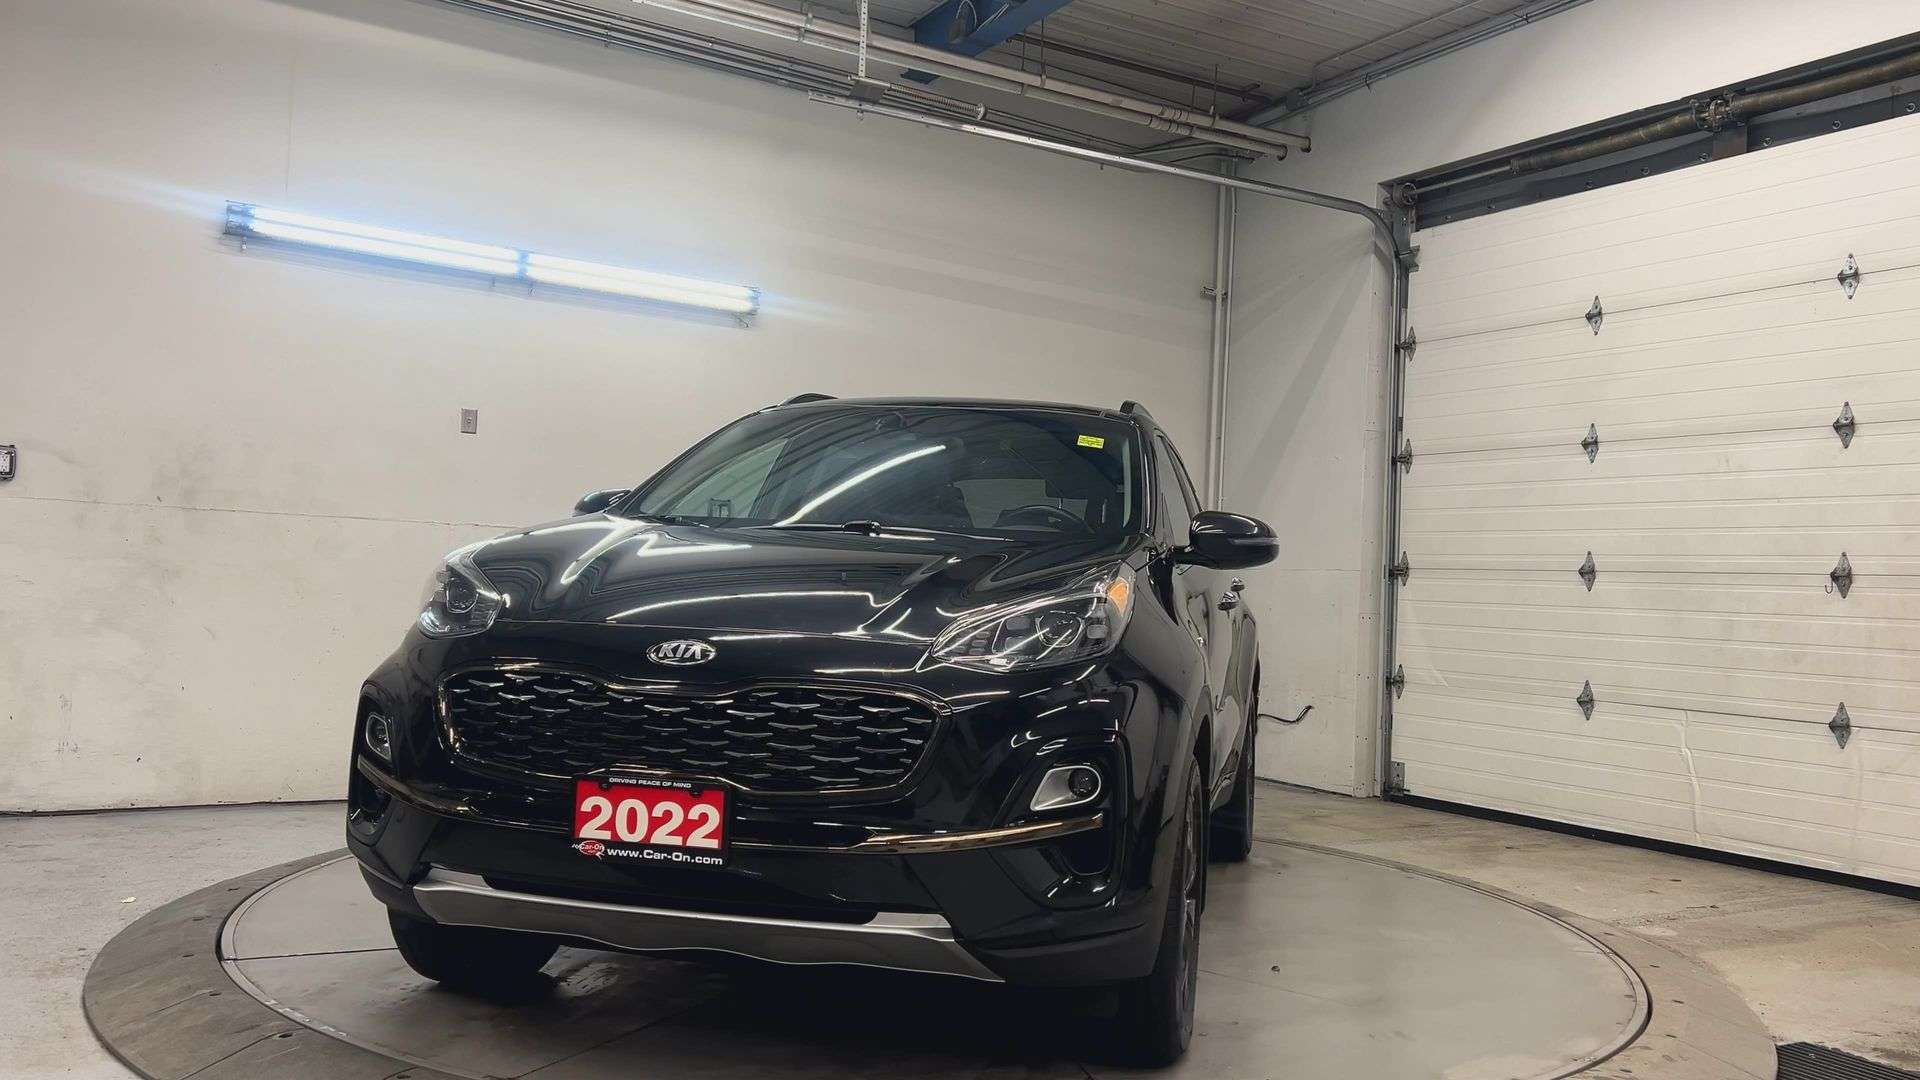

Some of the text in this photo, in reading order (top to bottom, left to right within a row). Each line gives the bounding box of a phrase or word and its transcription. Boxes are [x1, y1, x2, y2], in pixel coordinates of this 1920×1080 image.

[658, 643, 702, 659] KIA
[609, 777, 637, 785] DRIVING
[578, 796, 720, 849] 2022
[607, 848, 723, 865] www.Car-On.com
